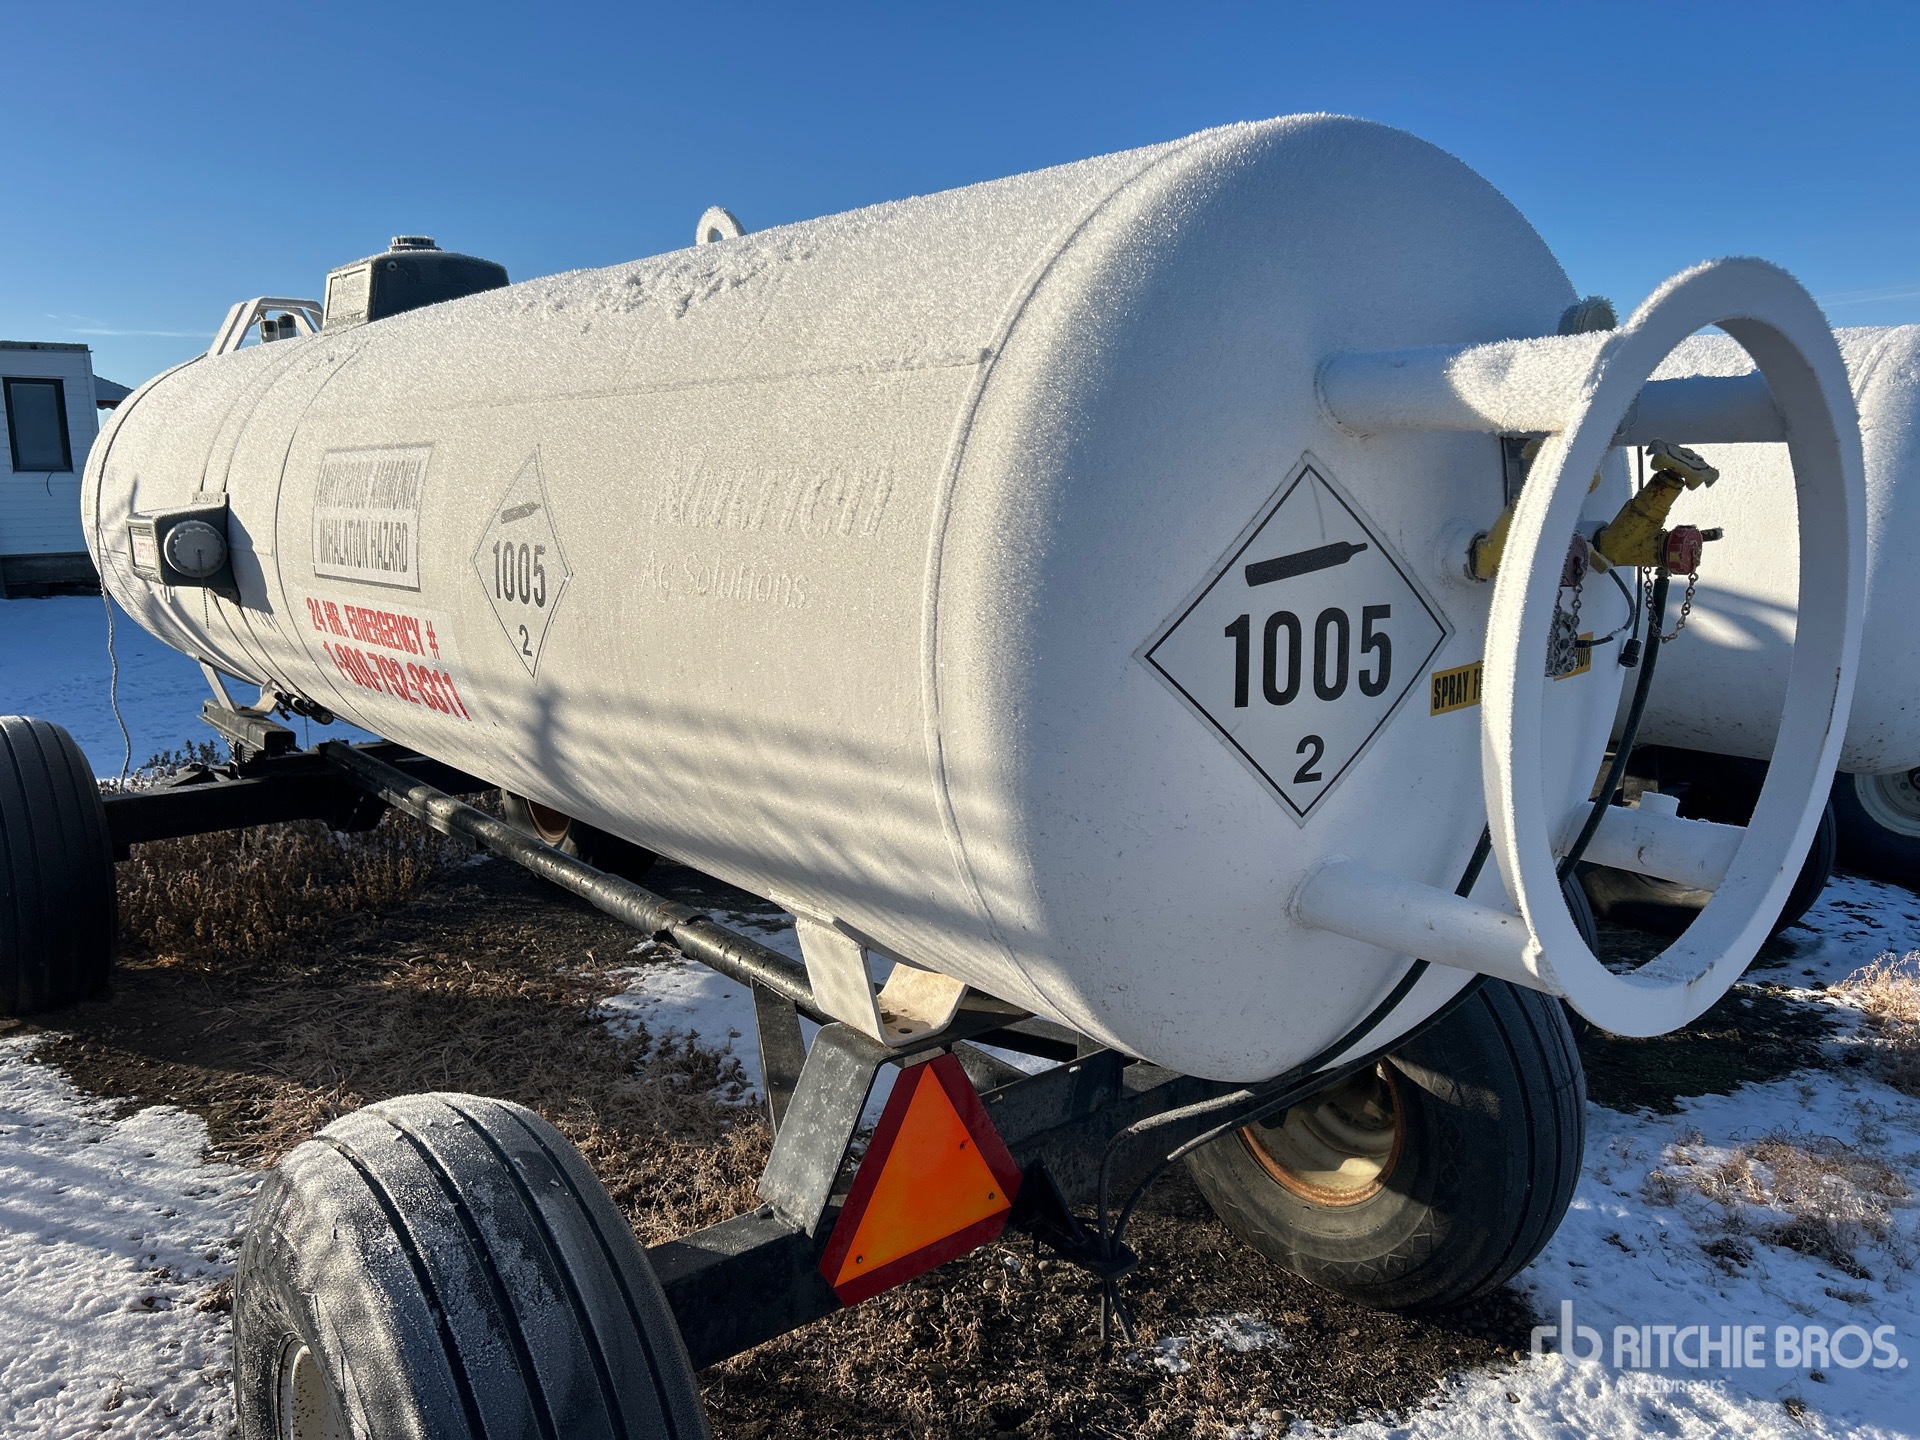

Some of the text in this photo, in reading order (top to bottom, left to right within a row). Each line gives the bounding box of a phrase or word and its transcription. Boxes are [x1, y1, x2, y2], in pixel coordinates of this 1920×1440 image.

[320, 518, 409, 573] INHALATION HAZARD
[492, 540, 547, 609] 1005
[306, 597, 441, 661] 24 HR. EMERGENCY #
[518, 624, 533, 657] 2
[1224, 604, 1392, 708] 1005
[1433, 670, 1469, 710] SPRAY
[1293, 734, 1325, 784] 2
